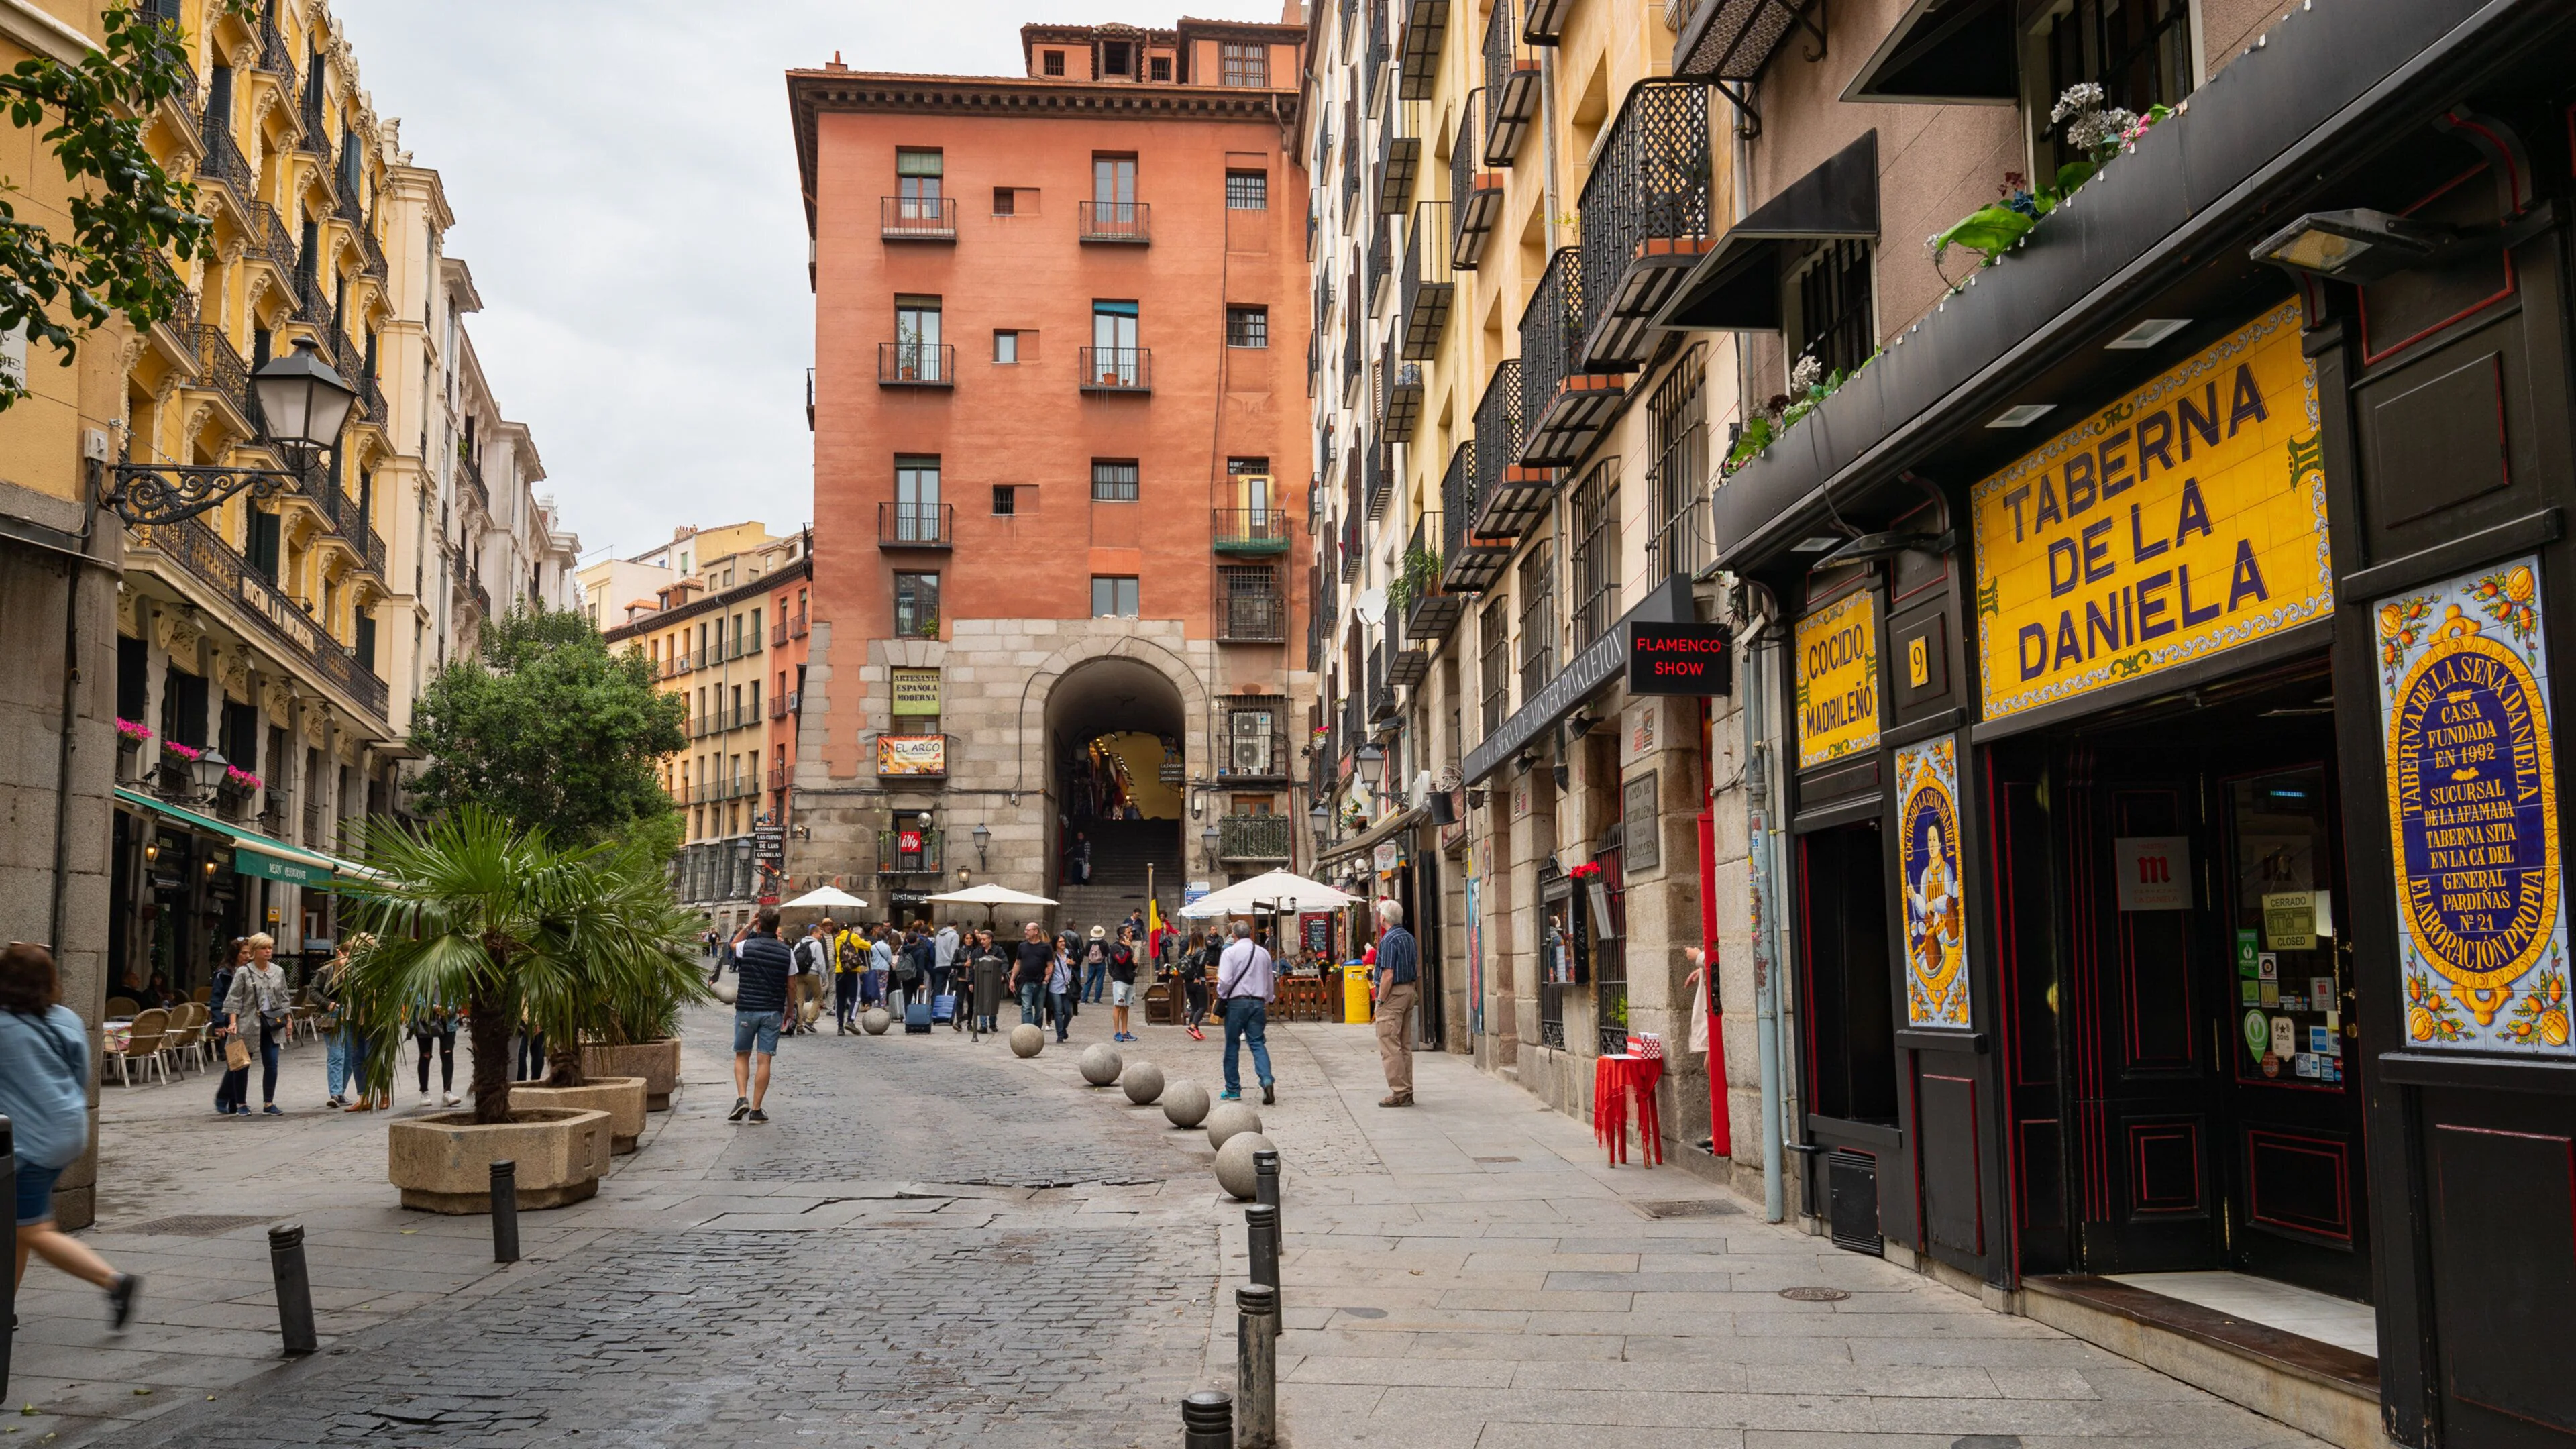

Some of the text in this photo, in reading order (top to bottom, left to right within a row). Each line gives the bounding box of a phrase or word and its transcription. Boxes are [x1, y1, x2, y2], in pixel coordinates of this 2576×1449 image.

[2003, 363, 2270, 543] TABERNA
[2048, 477, 2214, 600] DE LA
[243, 576, 270, 618] HOSTAL
[272, 600, 282, 627] LA
[2019, 538, 2271, 682] DANIELA
[1637, 638, 1721, 653] FLAMENCO
[1809, 623, 1864, 680] COCIDO
[1654, 661, 1704, 676] SHOW
[1913, 647, 1923, 678] 9
[896, 683, 938, 692] ESPAÑOLA
[2429, 661, 2458, 692] LA
[1481, 627, 1622, 769] LA TABERNA DE MISTER PINKLETON
[1807, 681, 1873, 738] MADRILEÑO
[2411, 679, 2436, 714] DE
[2441, 702, 2482, 724] CASA
[896, 743, 941, 753] EL ARCO
[2427, 720, 2498, 749] FUNDADA
[2502, 688, 2538, 803] DANIELA
[2400, 712, 2424, 816] TABERNA
[2435, 743, 2496, 769] EN 1992
[2430, 779, 2506, 806] SUCURSAL
[2424, 800, 2516, 827] DE LA AFAMADA
[901, 833, 920, 851] illy
[1905, 818, 1915, 861] COCIDO
[1940, 802, 1955, 858] DANIELA
[2426, 823, 2517, 849] TABERNA SITA
[2431, 849, 2447, 869] EN
[2451, 849, 2468, 867] LA
[2489, 845, 2515, 864] DEL
[790, 875, 909, 890] LAS CUEVAS
[2443, 869, 2506, 890] GENERAL
[2270, 896, 2306, 908] CERRADO
[2442, 890, 2511, 912] PARDIÑAS
[2410, 869, 2543, 969] ELABORACIÓN PROPIA
[2477, 914, 2493, 930] 21
[2277, 936, 2306, 946] CLOSED
